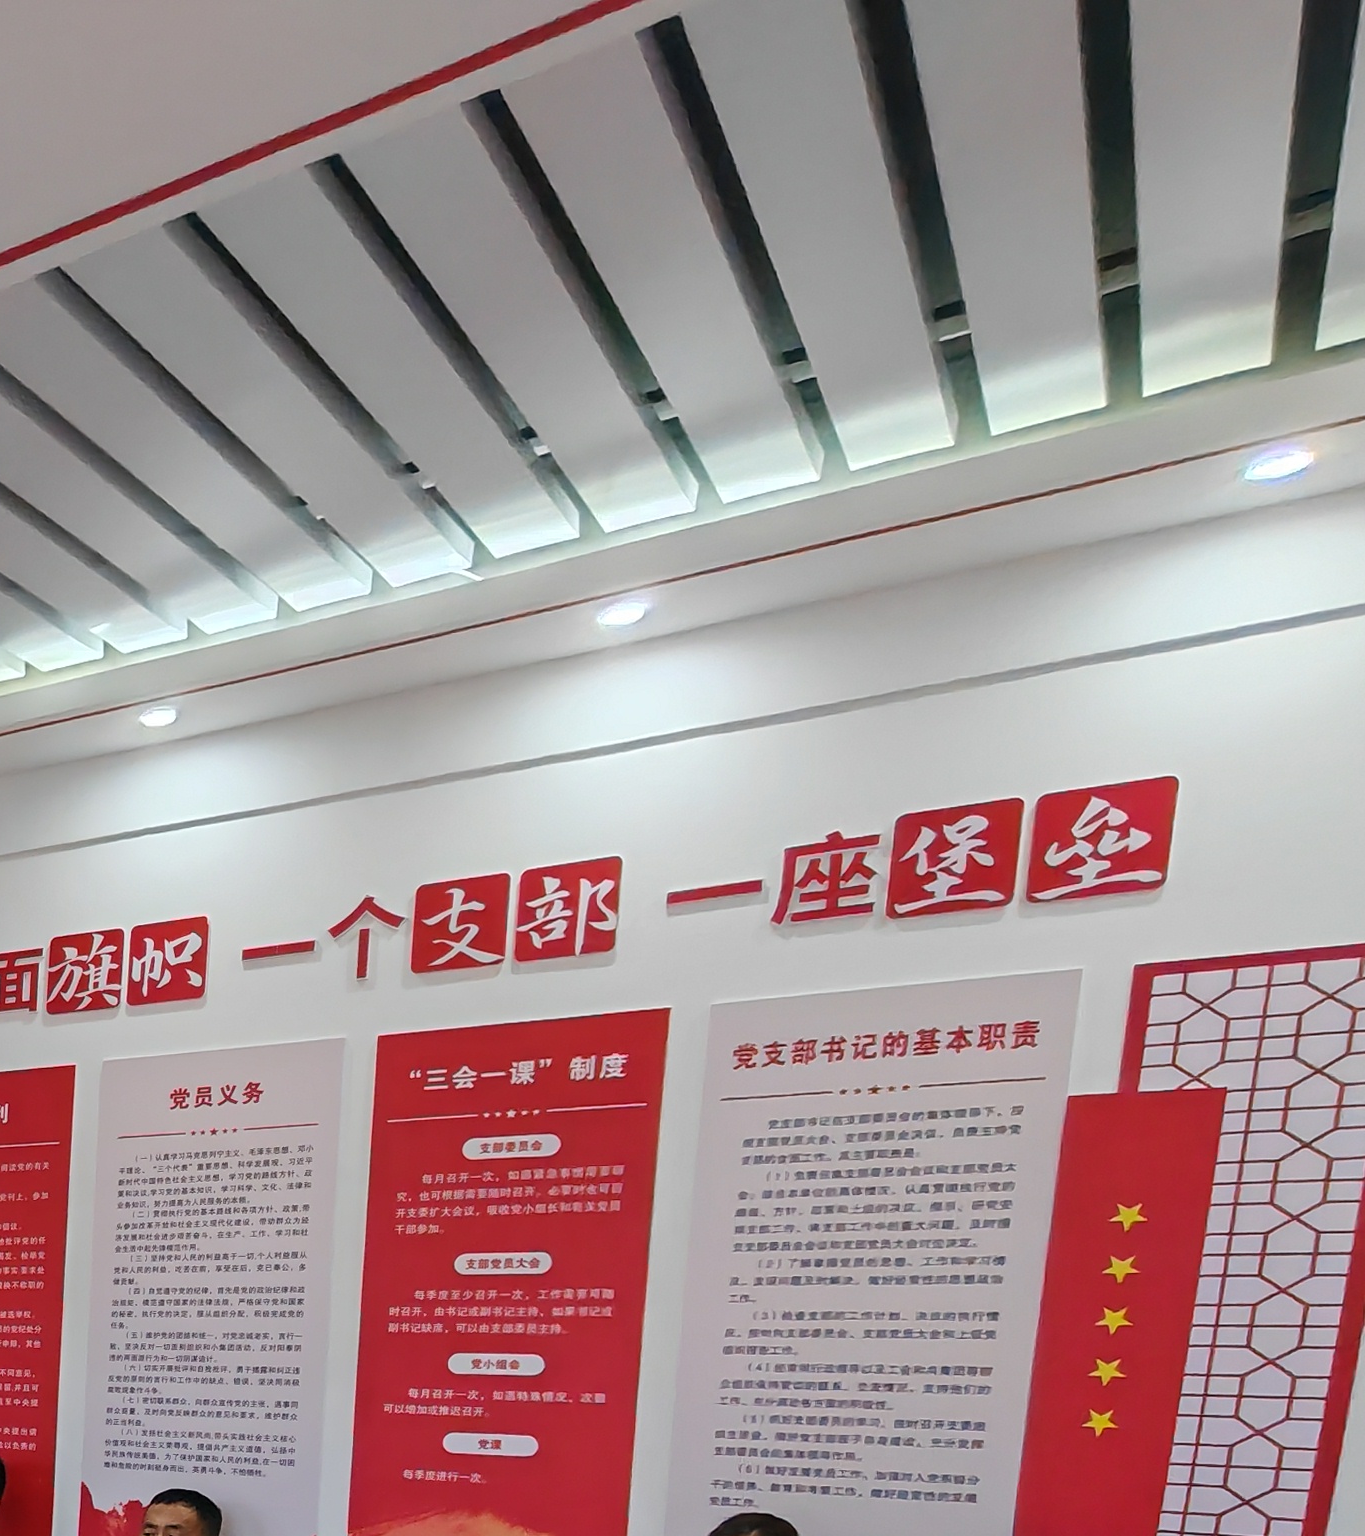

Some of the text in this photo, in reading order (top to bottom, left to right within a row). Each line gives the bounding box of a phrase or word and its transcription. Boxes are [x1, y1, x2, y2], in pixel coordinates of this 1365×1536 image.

[241, 876, 619, 981] 一个支部
[667, 796, 1162, 927] 一座堡垒
[732, 1019, 1041, 1071] 党支部书记的基本职责
[170, 1080, 264, 1110] 党员义务
[480, 1140, 543, 1154] 支部委员会
[465, 1257, 541, 1270] 支部党员大会
[471, 1359, 520, 1370] 党小组会
[478, 1439, 502, 1450] 党课
